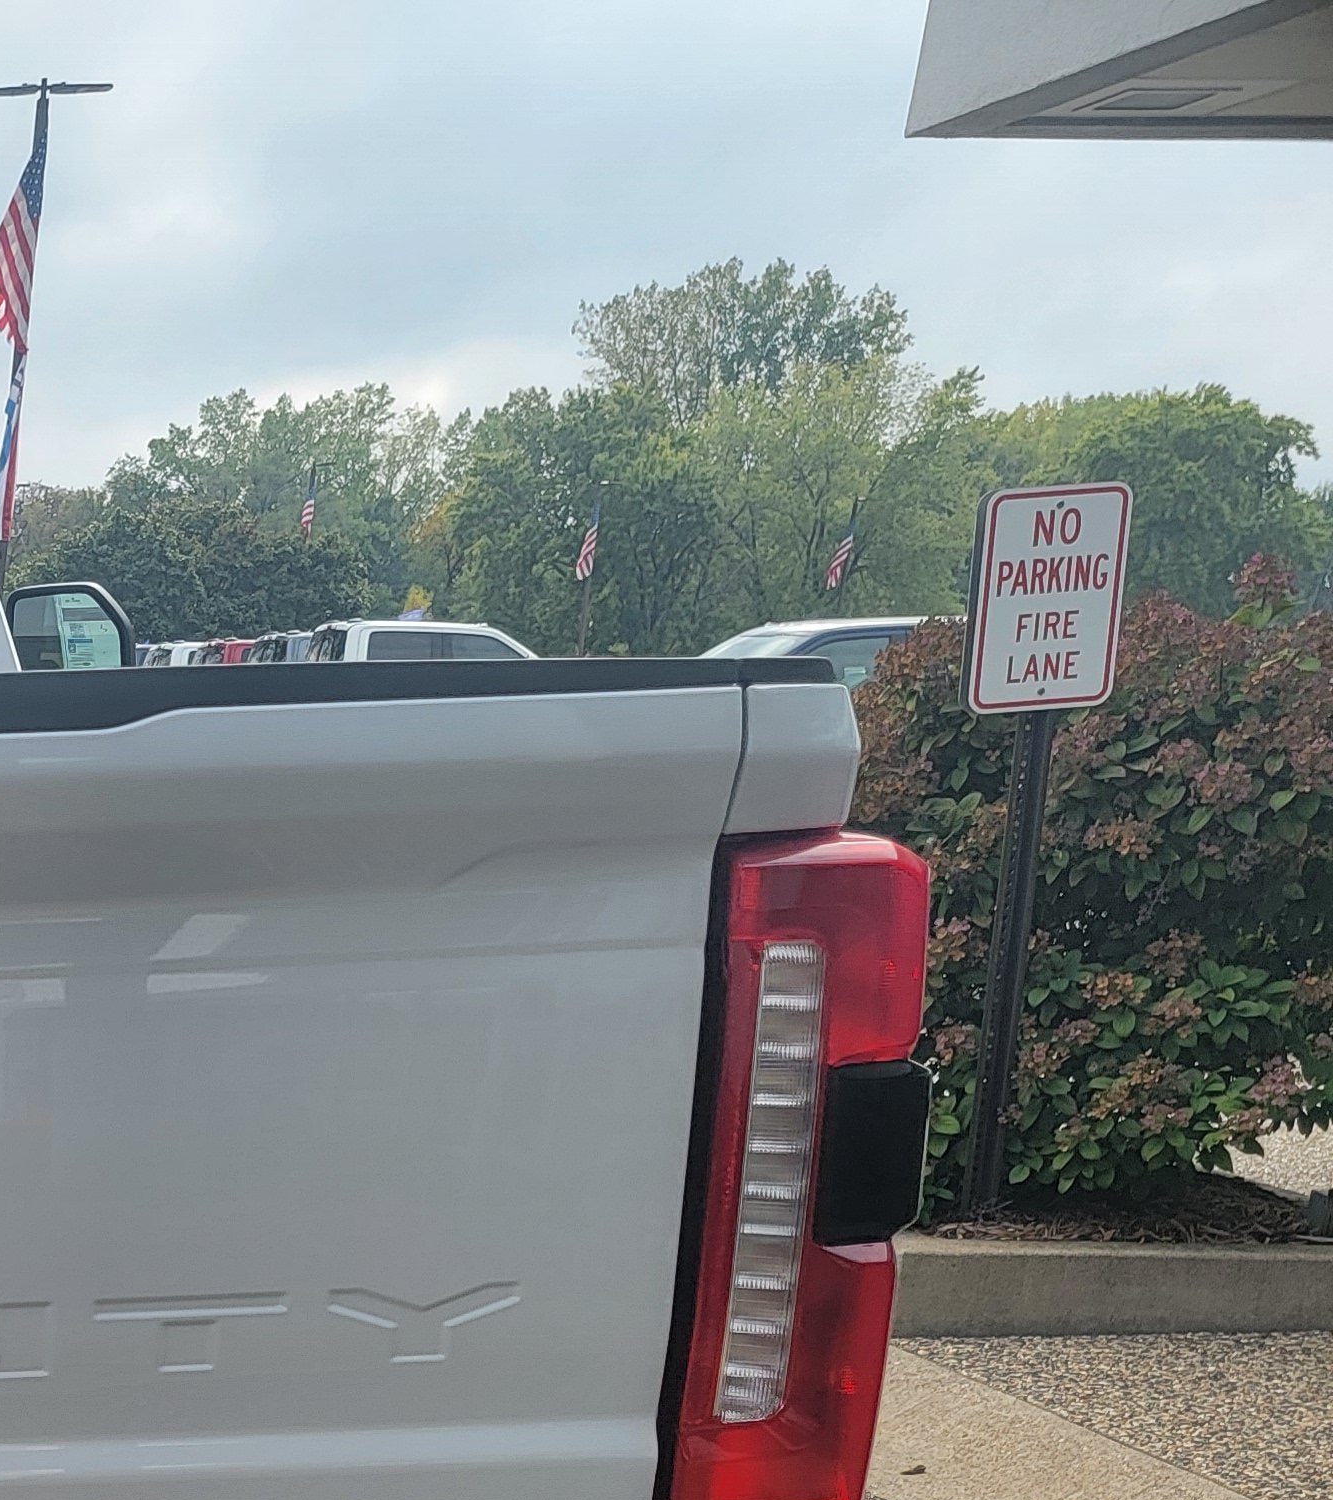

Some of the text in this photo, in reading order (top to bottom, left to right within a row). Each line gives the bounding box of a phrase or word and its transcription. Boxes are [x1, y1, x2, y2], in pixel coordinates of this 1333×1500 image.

[1032, 507, 1082, 548] NO
[995, 553, 1110, 598] PARKING
[1015, 609, 1080, 643] FIRE
[1005, 650, 1081, 684] LANE
